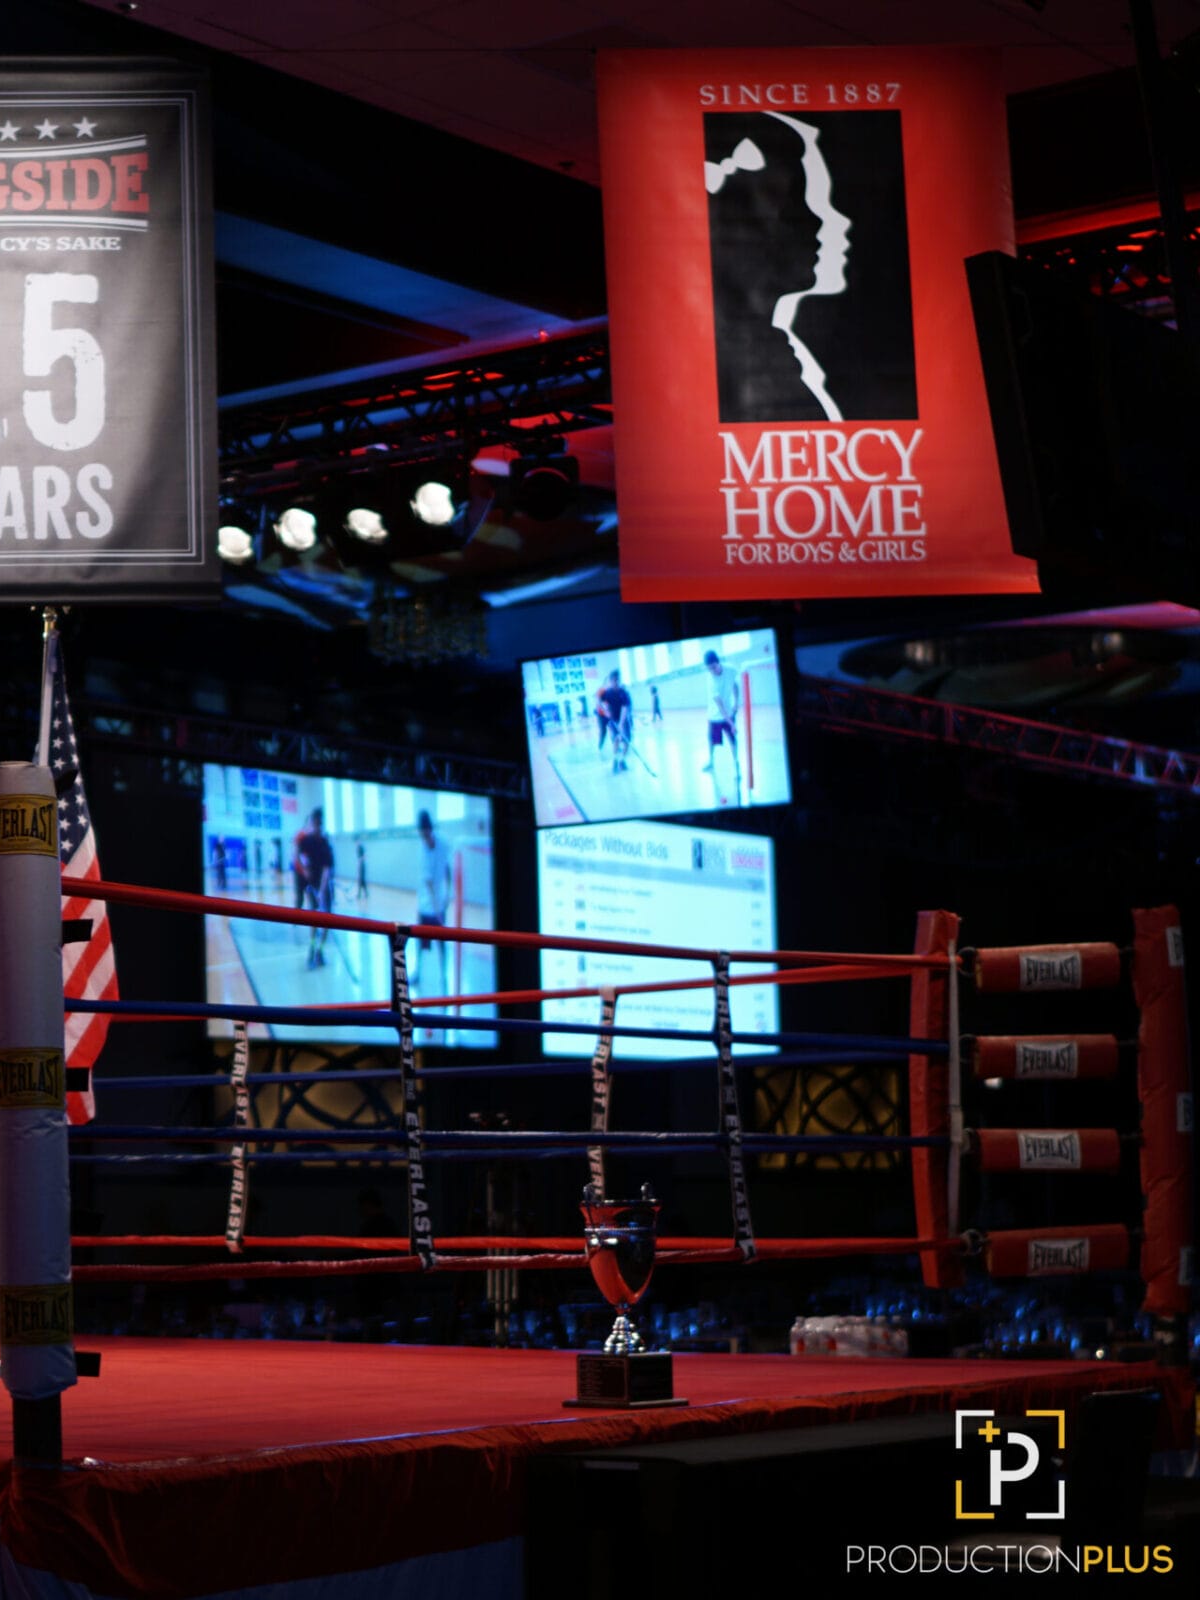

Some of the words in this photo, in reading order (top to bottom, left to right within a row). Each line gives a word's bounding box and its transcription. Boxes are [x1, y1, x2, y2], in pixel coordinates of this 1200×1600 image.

[699, 84, 809, 106] SINCE
[825, 83, 901, 104] 1887
[56, 235, 122, 252] SAKE
[718, 428, 924, 485] MERCY
[720, 484, 927, 539] HOME
[726, 542, 772, 564] FOR
[776, 541, 834, 564] BOYS
[544, 830, 598, 852] Packages
[601, 837, 643, 859] Without
[646, 844, 669, 861] Bids
[1025, 954, 1078, 985] EVERLAST
[1022, 1042, 1075, 1073] EVERLAST
[1024, 1134, 1075, 1163] EVERLAST
[1034, 1242, 1085, 1271] EVERLAST
[5, 1291, 70, 1338] EVERLAST
